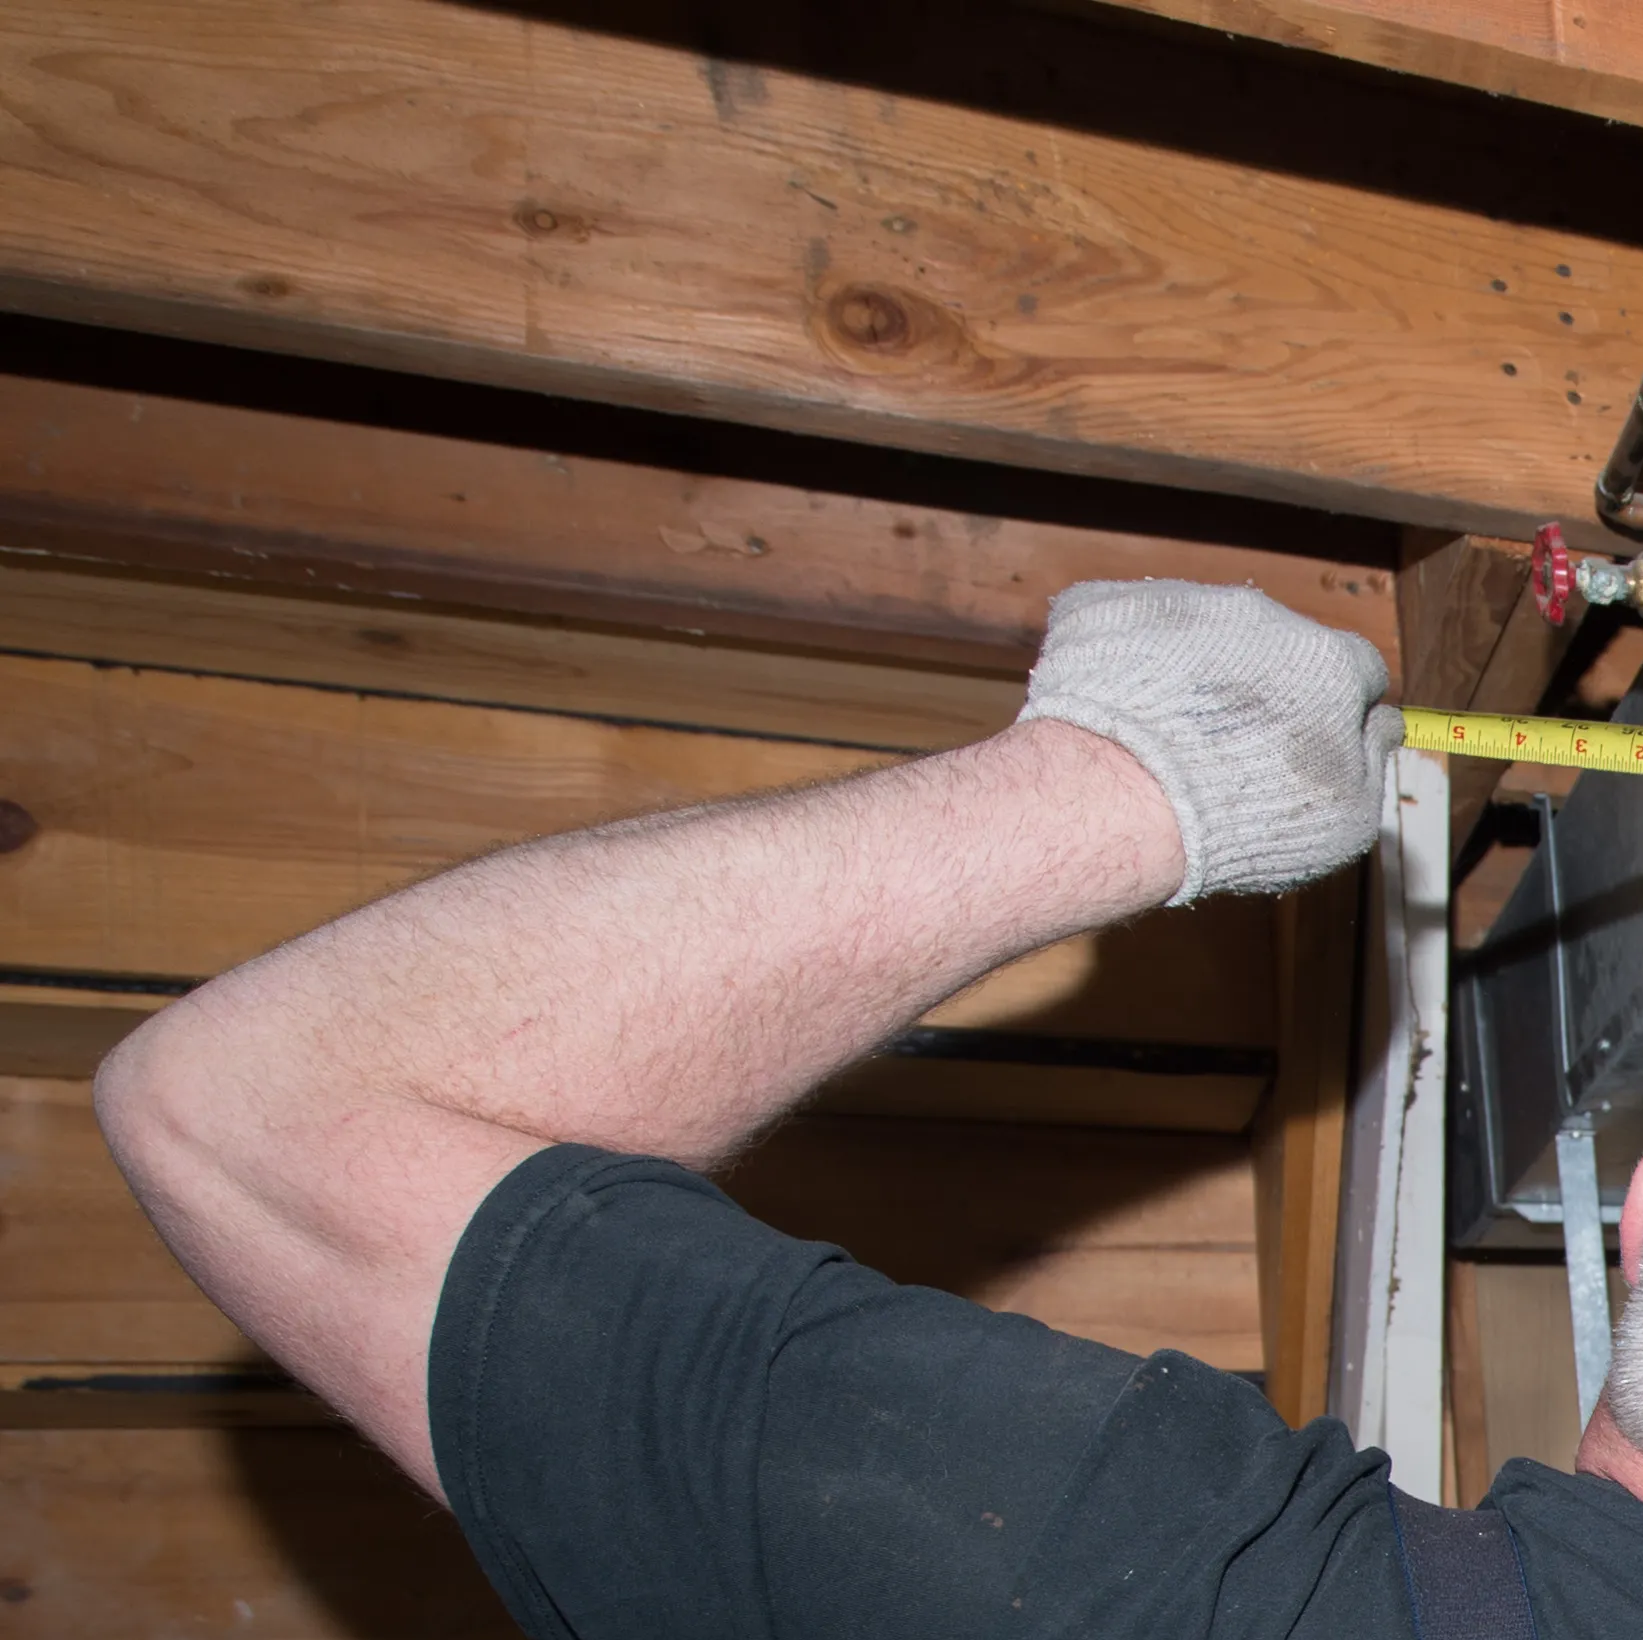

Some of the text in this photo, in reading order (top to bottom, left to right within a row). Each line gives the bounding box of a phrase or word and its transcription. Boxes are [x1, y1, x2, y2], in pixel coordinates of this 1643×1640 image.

[1453, 726, 1466, 740] 5
[1515, 732, 1527, 745] 4
[1575, 738, 1588, 753] 3
